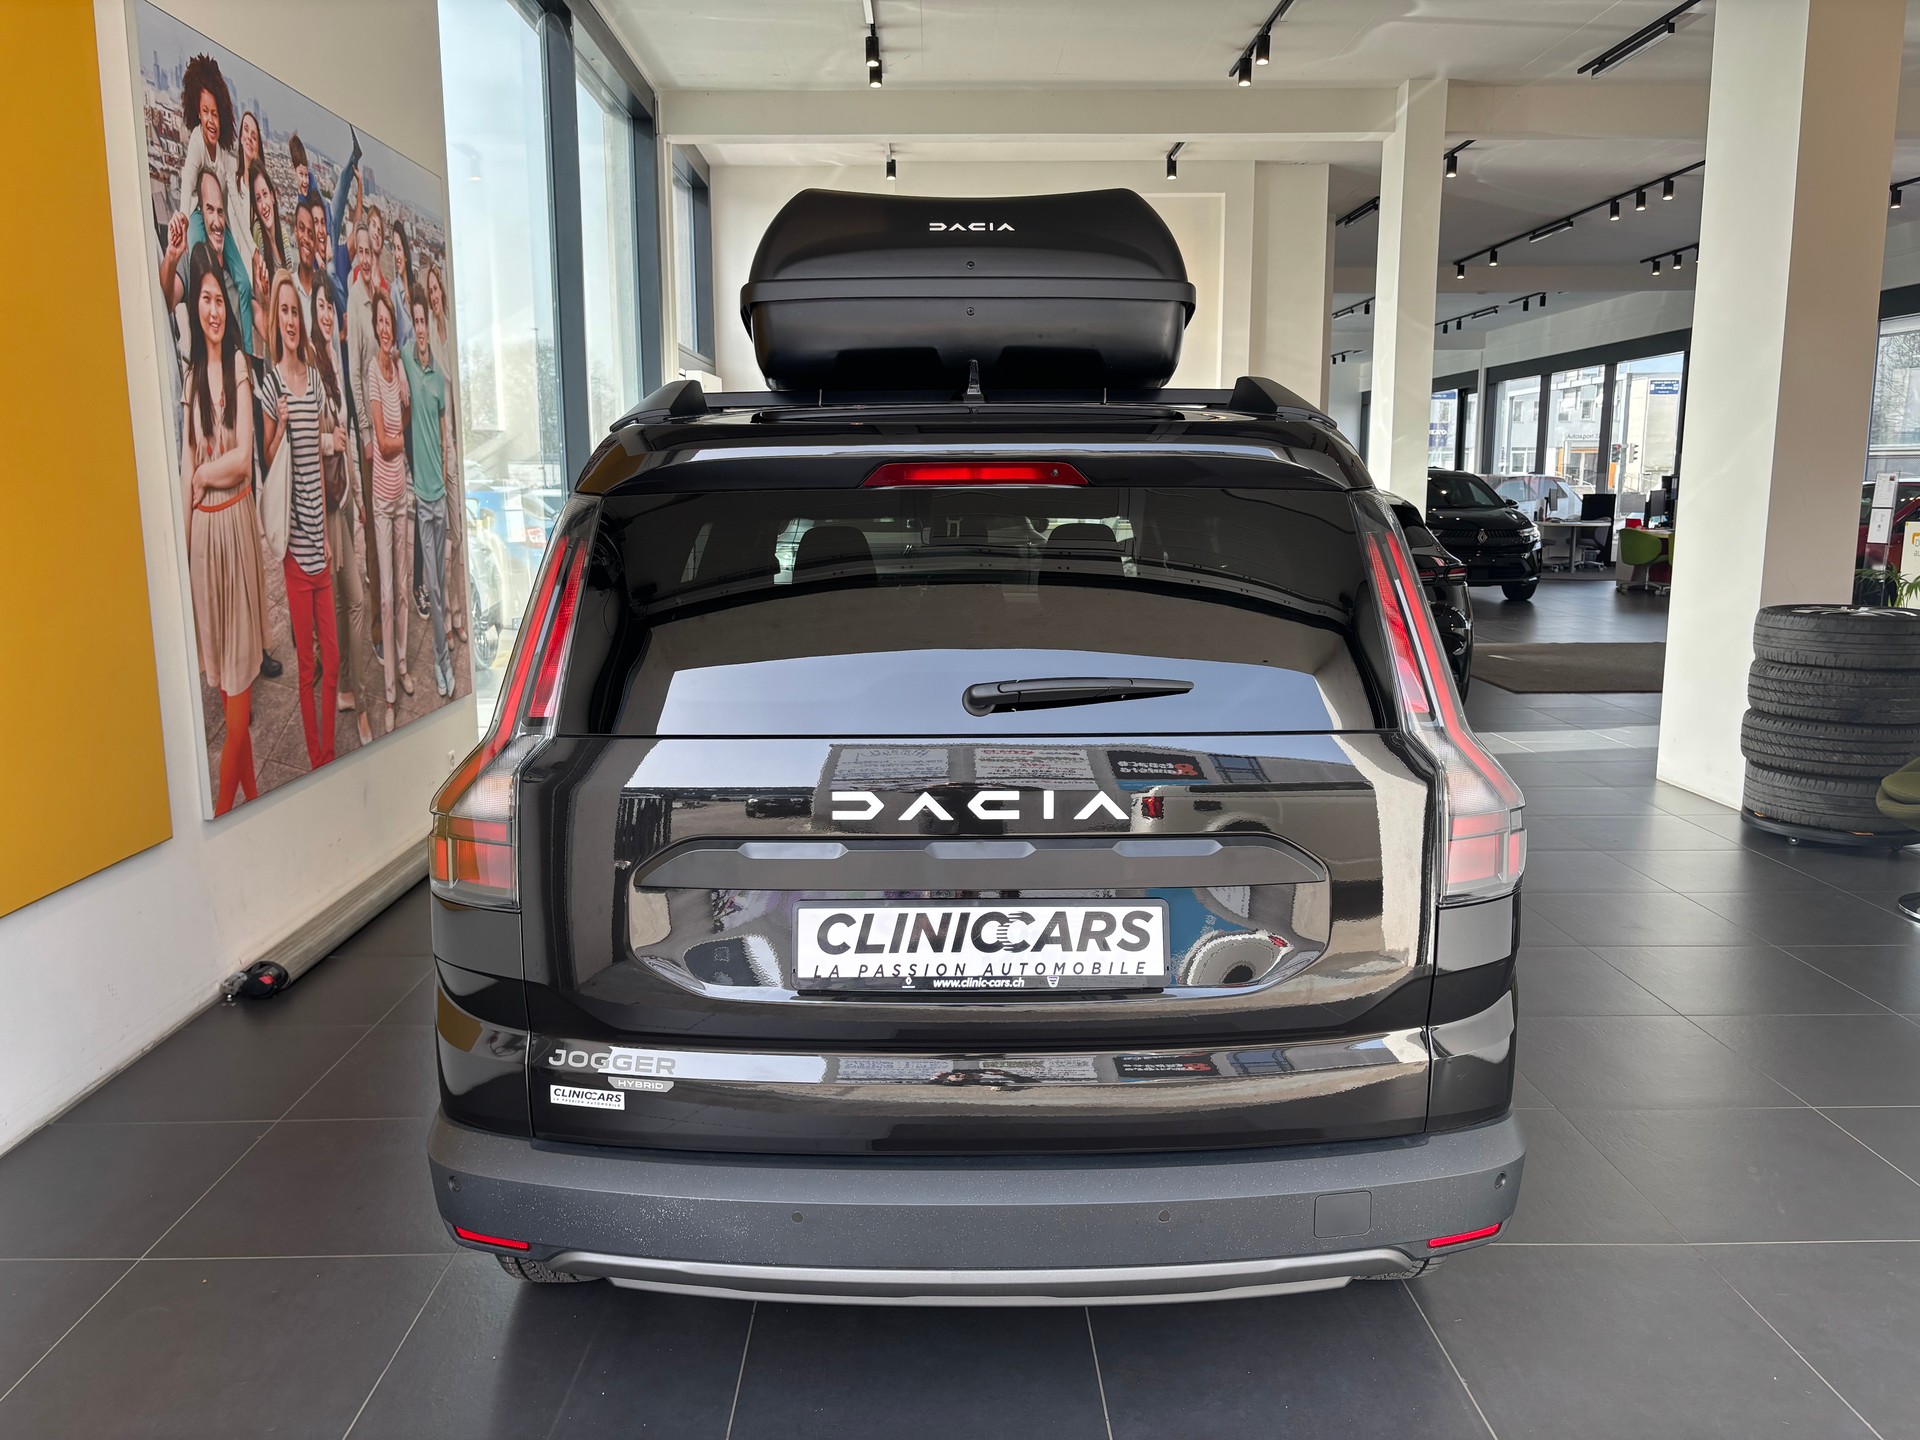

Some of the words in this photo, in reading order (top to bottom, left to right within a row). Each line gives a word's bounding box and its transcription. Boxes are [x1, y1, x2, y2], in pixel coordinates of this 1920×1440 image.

[929, 222, 1015, 231] DACIA
[831, 790, 1129, 821] DACIA
[814, 965, 840, 978] LA
[858, 963, 966, 977] PASSION
[983, 961, 1147, 976] AUTOMOBILE
[933, 977, 1026, 989] www.clinic-cars.ch
[549, 1049, 676, 1074] JOGGER
[618, 1079, 664, 1090] HYBRID
